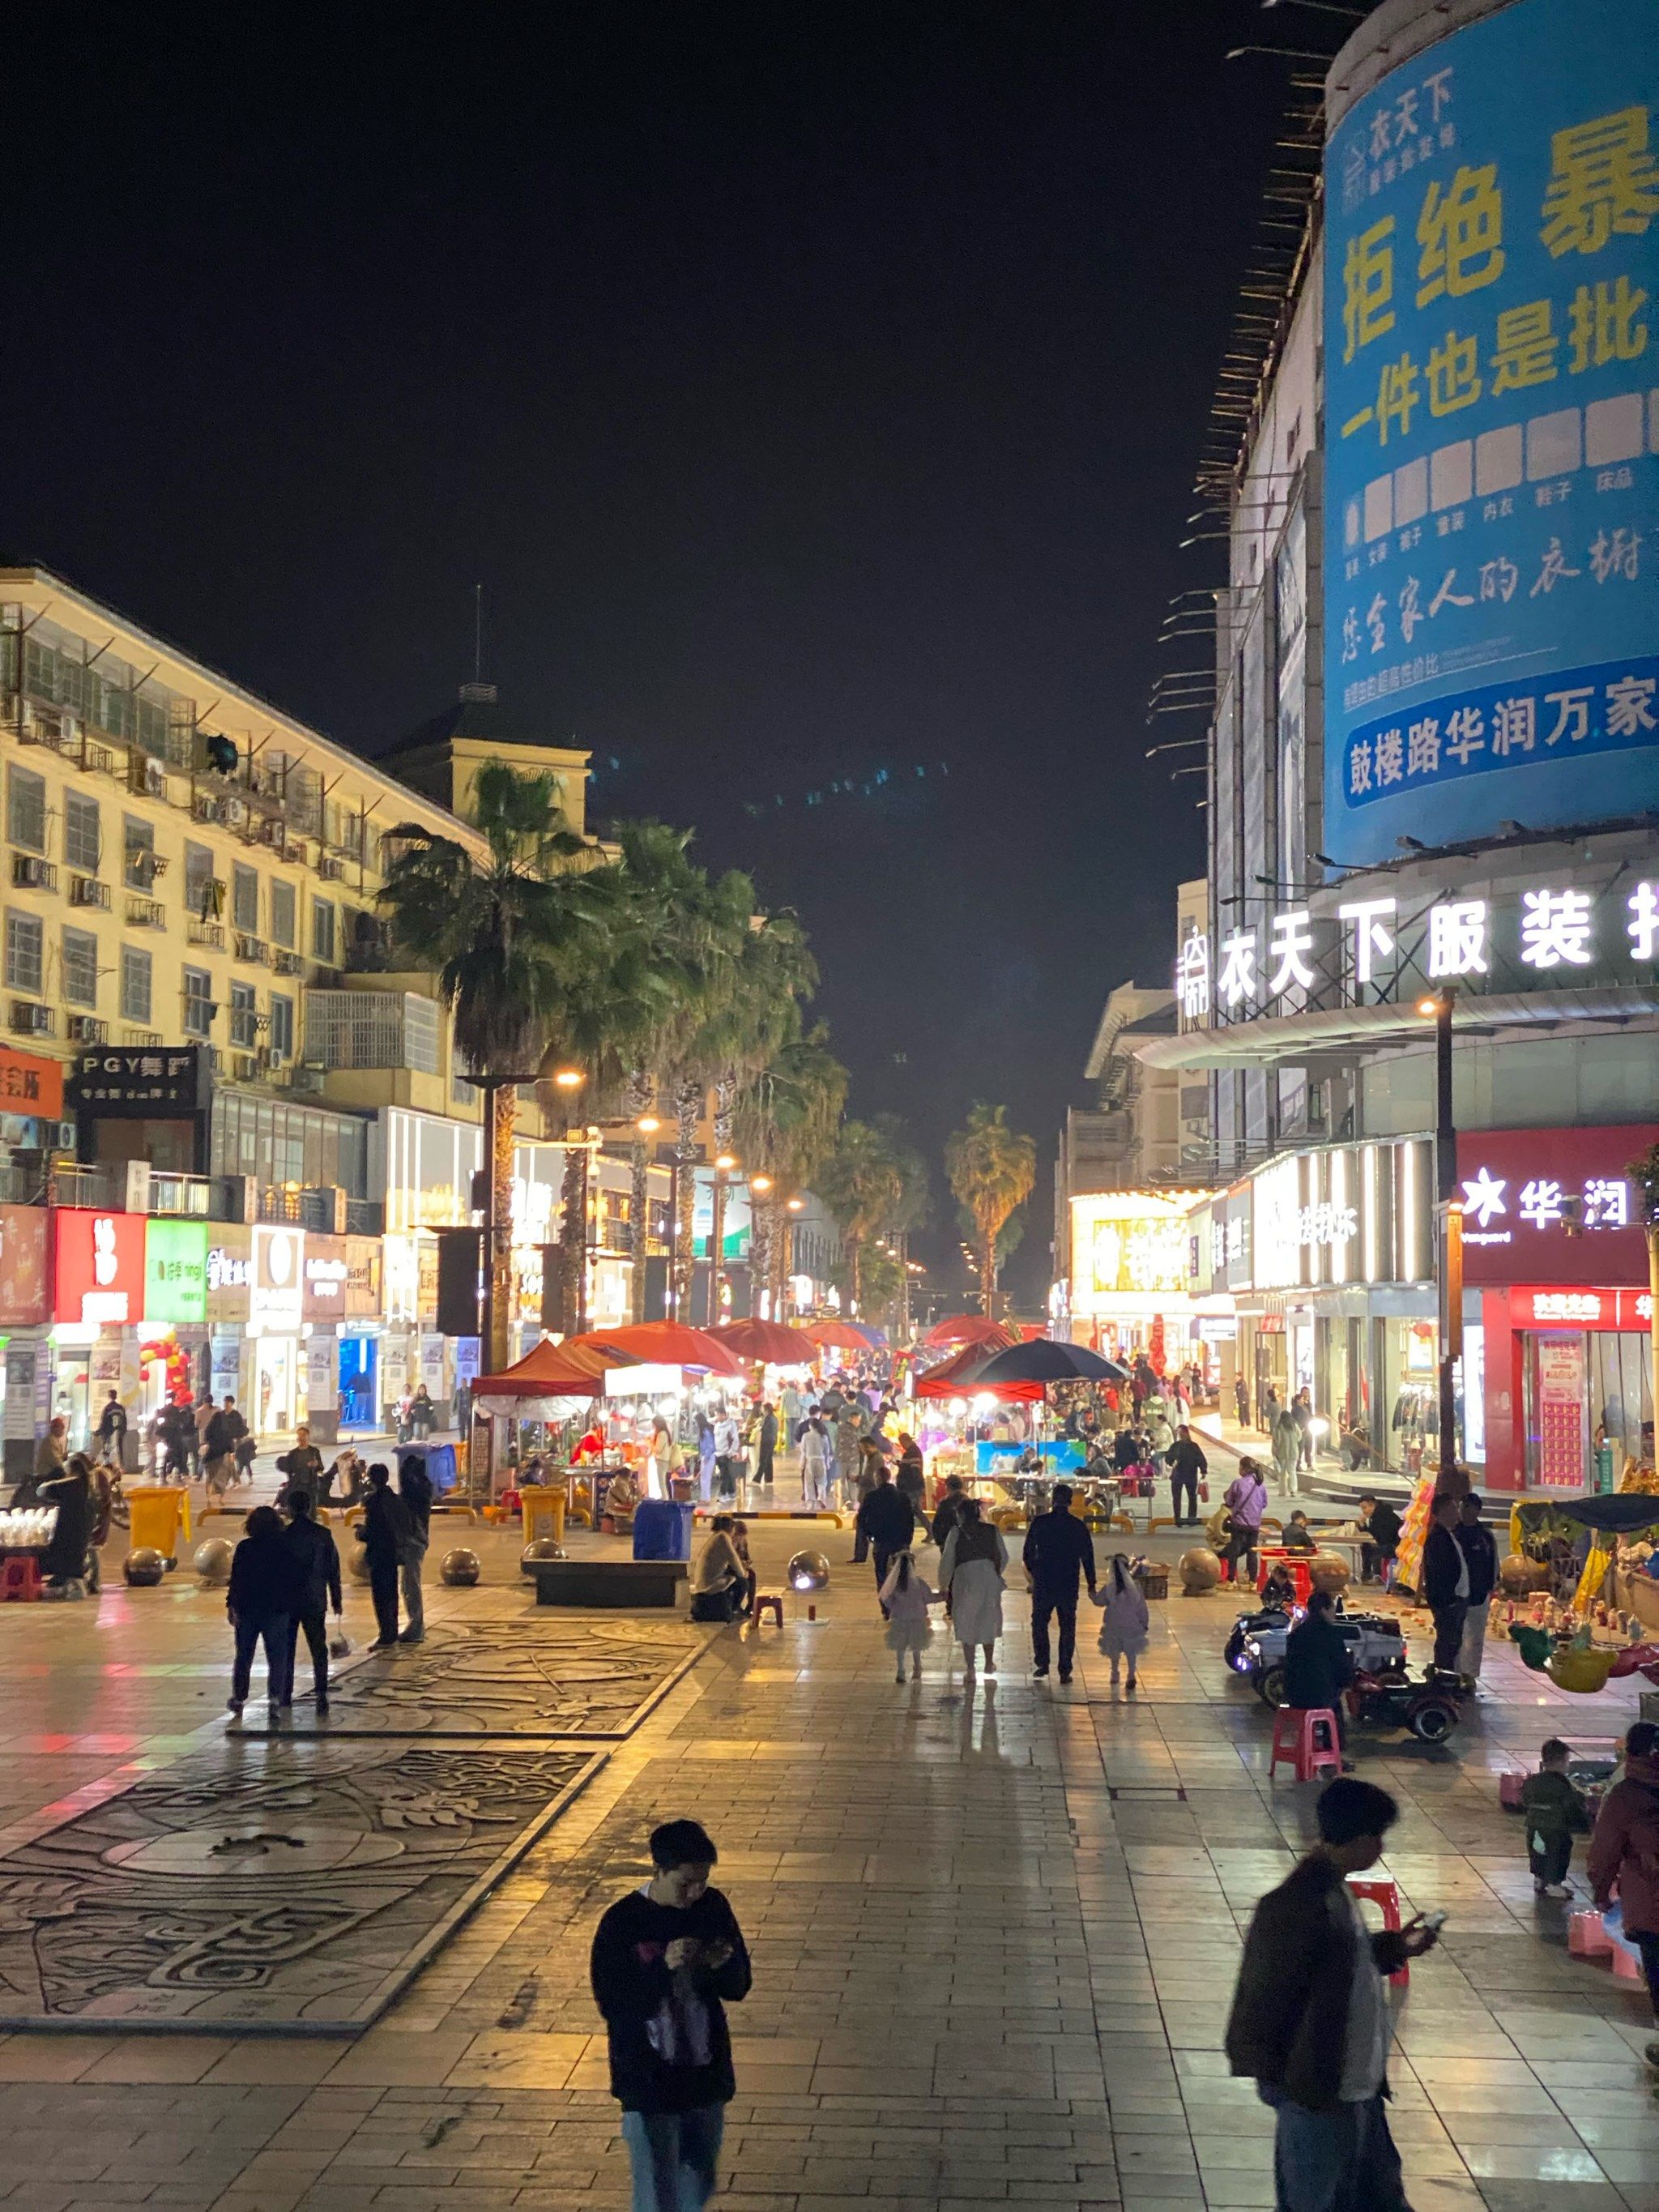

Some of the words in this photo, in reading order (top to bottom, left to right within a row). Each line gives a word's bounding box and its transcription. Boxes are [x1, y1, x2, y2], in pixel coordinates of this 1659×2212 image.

[1341, 275, 1648, 446] 一件也是批
[1350, 675, 1659, 796] 鼓楼路华润万家
